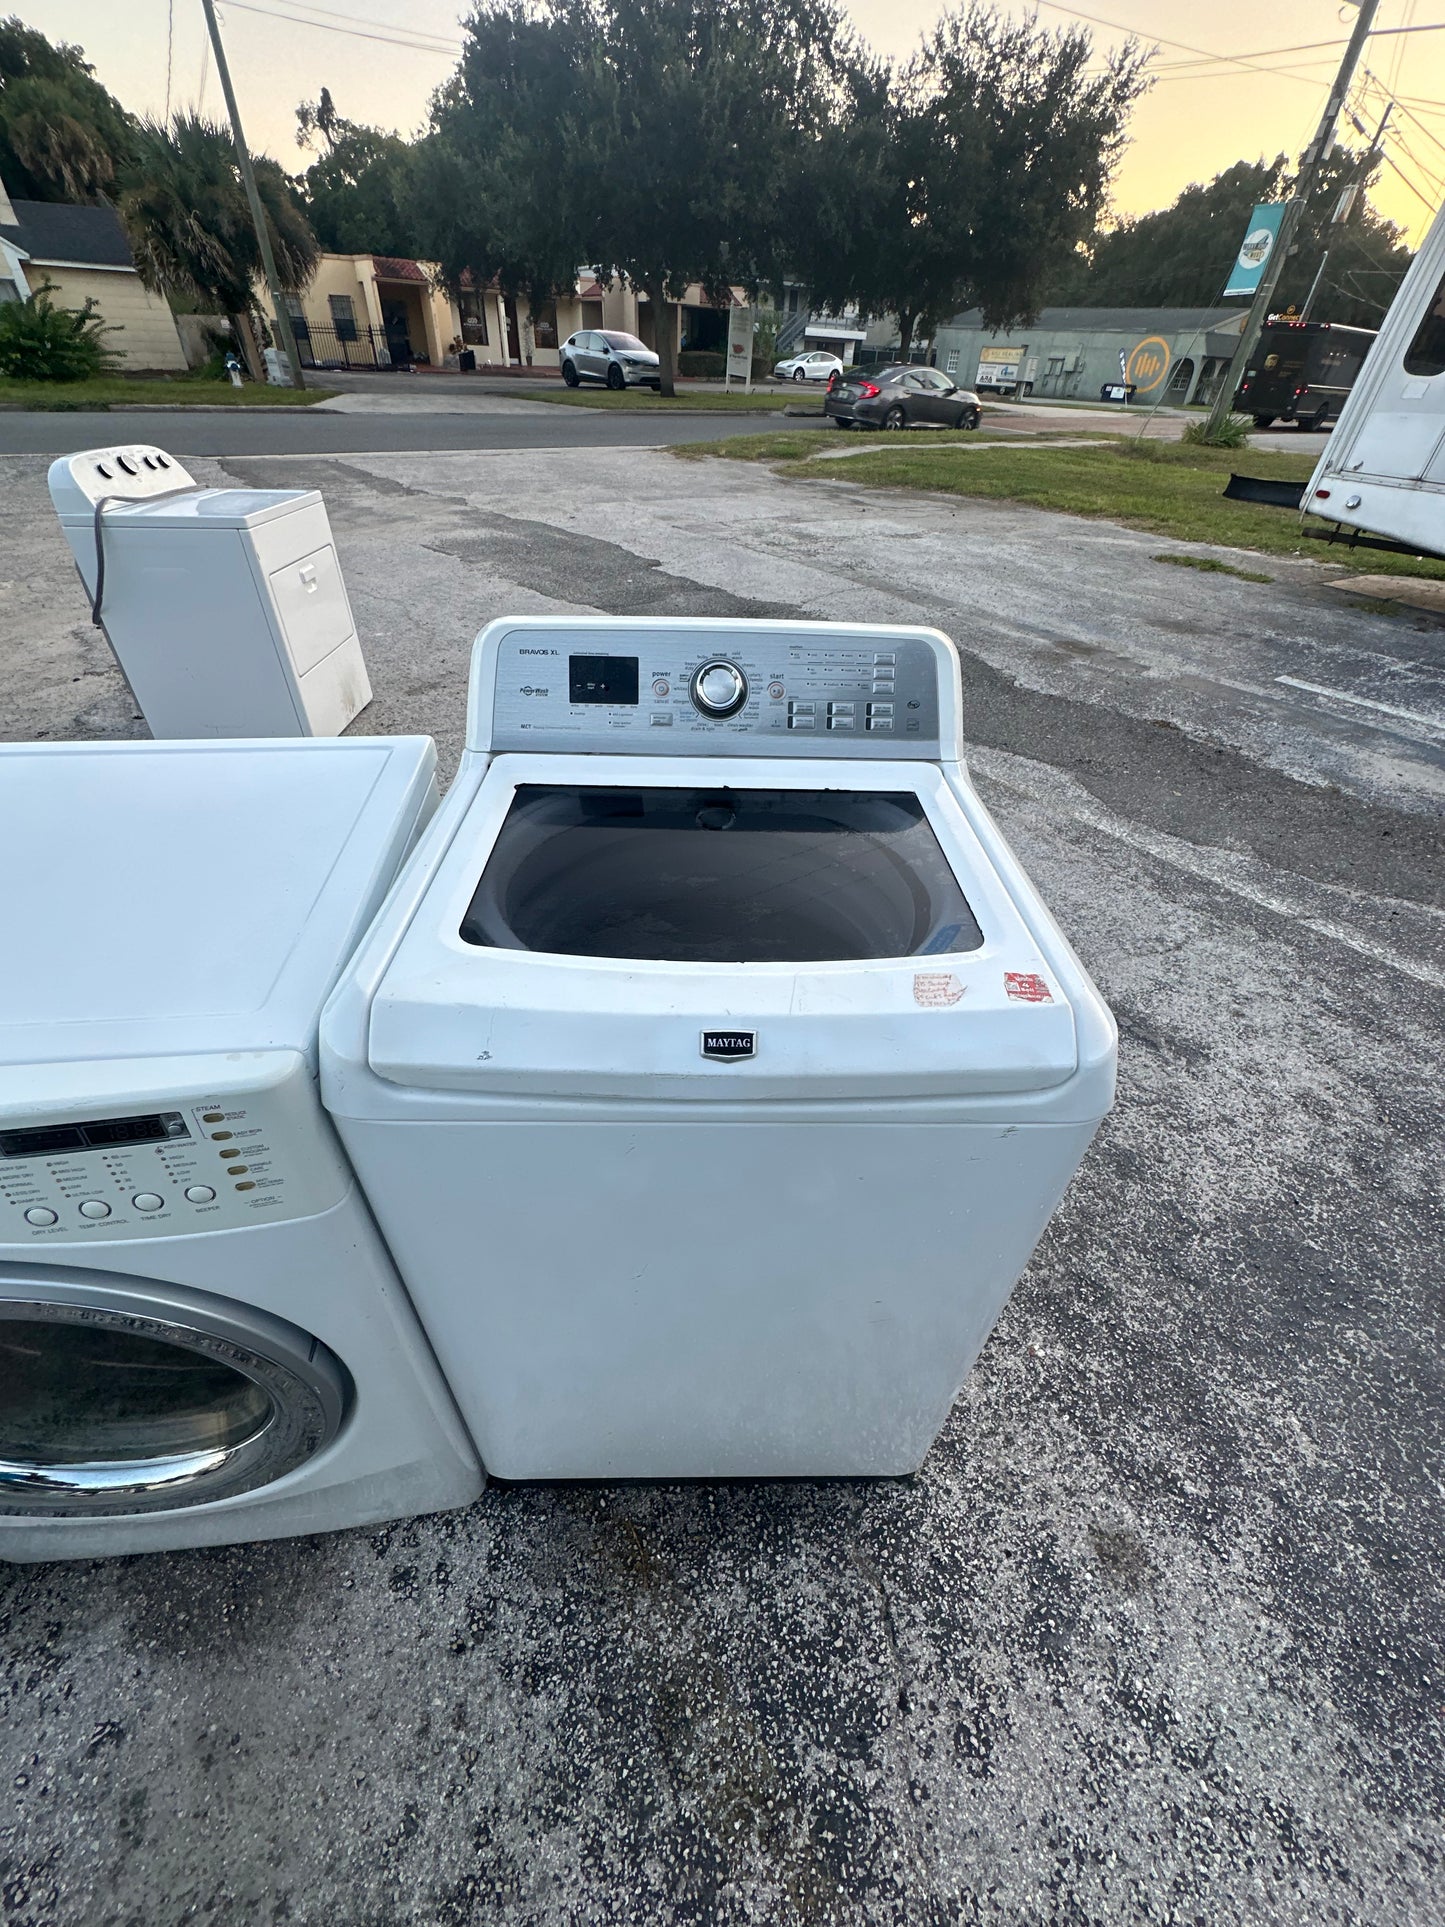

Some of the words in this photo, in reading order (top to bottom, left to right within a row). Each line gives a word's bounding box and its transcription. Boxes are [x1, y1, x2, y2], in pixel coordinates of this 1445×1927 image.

[707, 1038, 751, 1048] MAYTAG
[196, 1104, 221, 1112] STEAM
[195, 1205, 220, 1213] BEEPER
